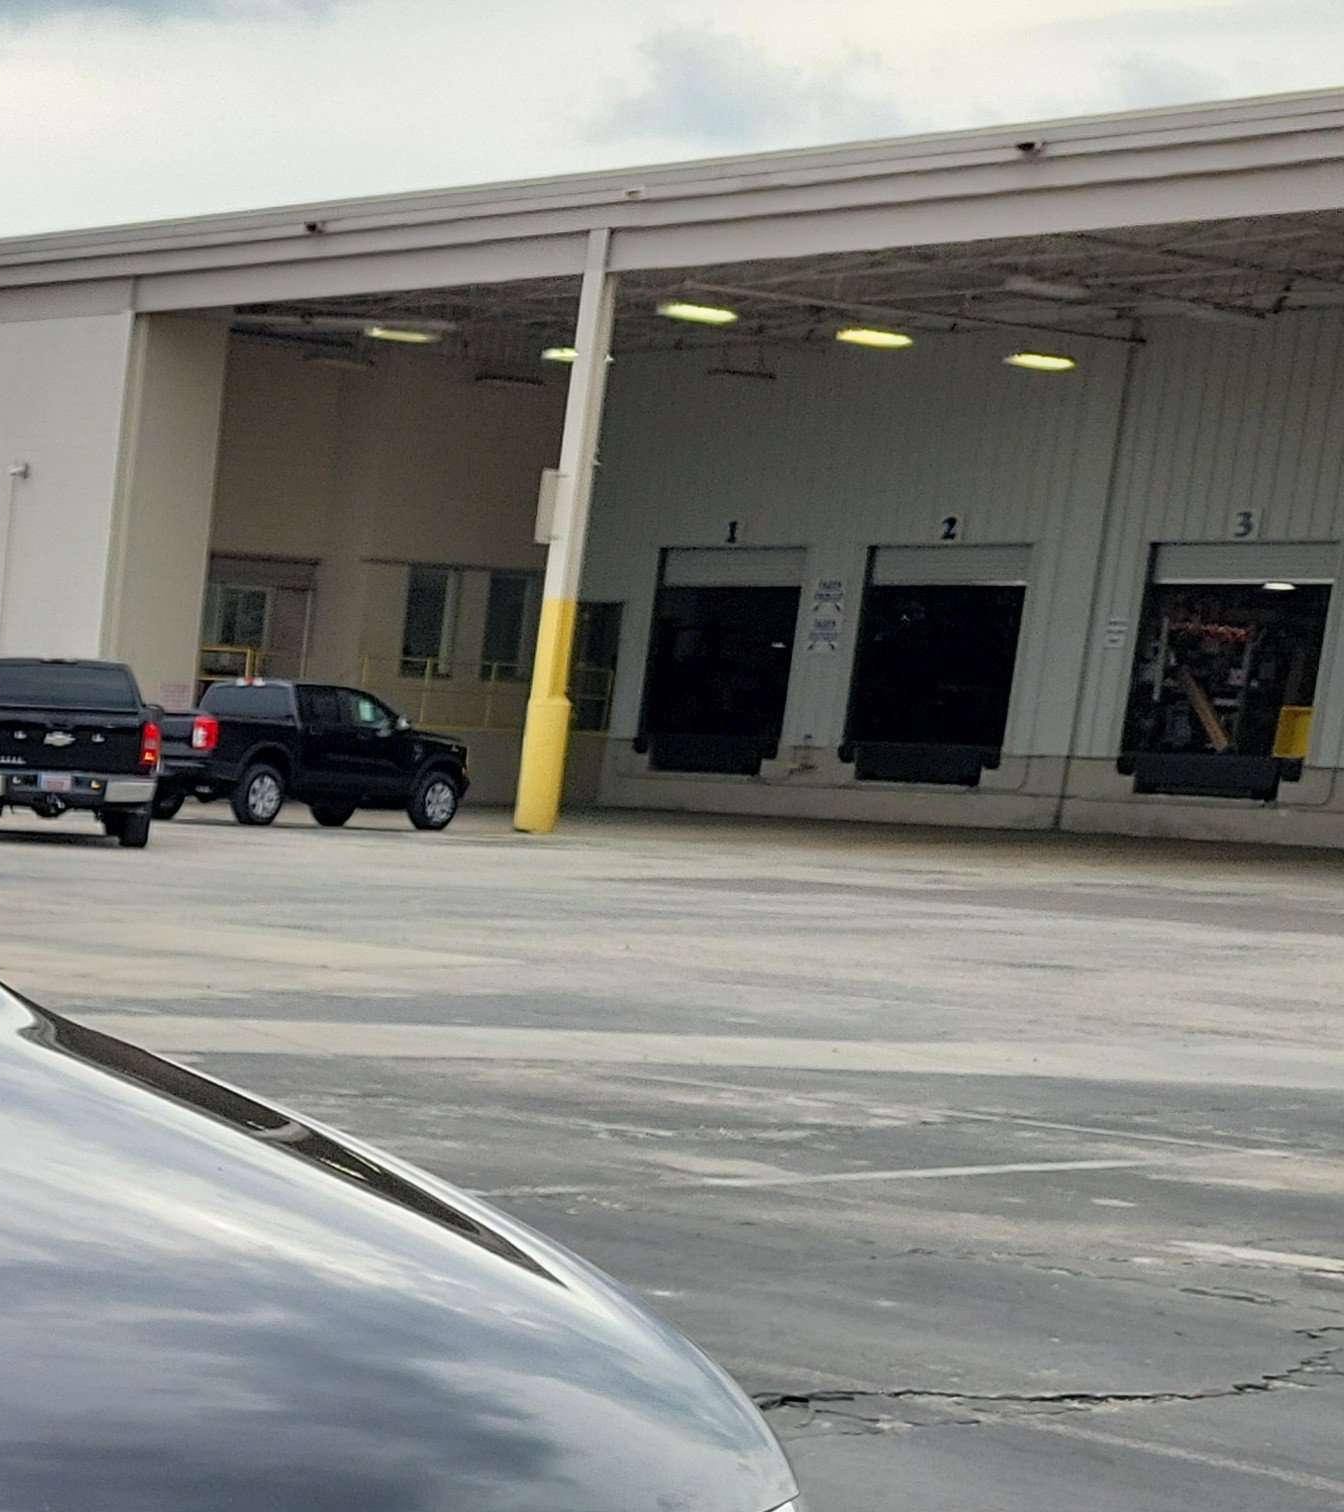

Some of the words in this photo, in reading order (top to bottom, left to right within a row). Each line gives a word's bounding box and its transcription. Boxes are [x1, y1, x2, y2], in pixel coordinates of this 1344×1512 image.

[726, 519, 739, 544] 1
[941, 515, 958, 541] 2
[1233, 511, 1253, 537] 3
